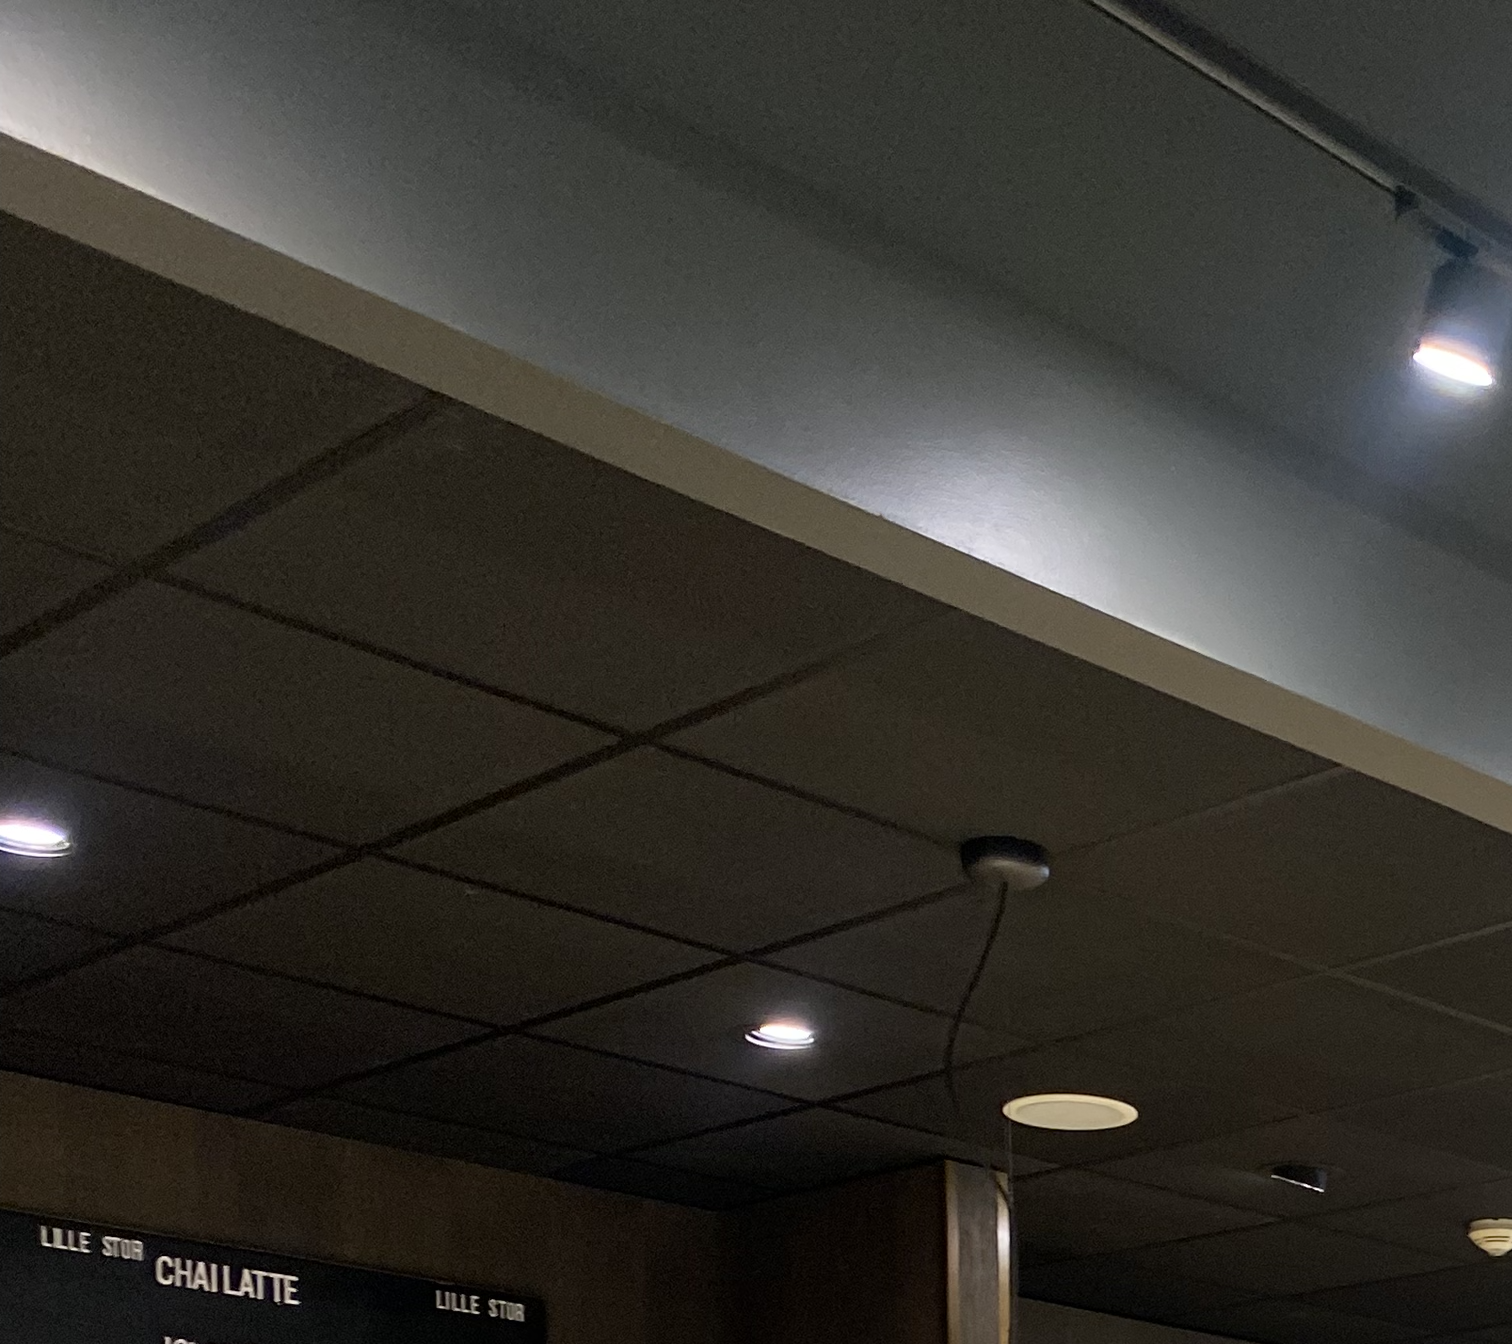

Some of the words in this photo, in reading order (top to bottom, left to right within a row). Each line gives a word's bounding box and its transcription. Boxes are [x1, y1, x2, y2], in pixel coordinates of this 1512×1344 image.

[41, 1225, 91, 1254] LILLE
[102, 1235, 144, 1261] STOR
[436, 1290, 480, 1315] LILLE
[488, 1298, 525, 1322] STOR
